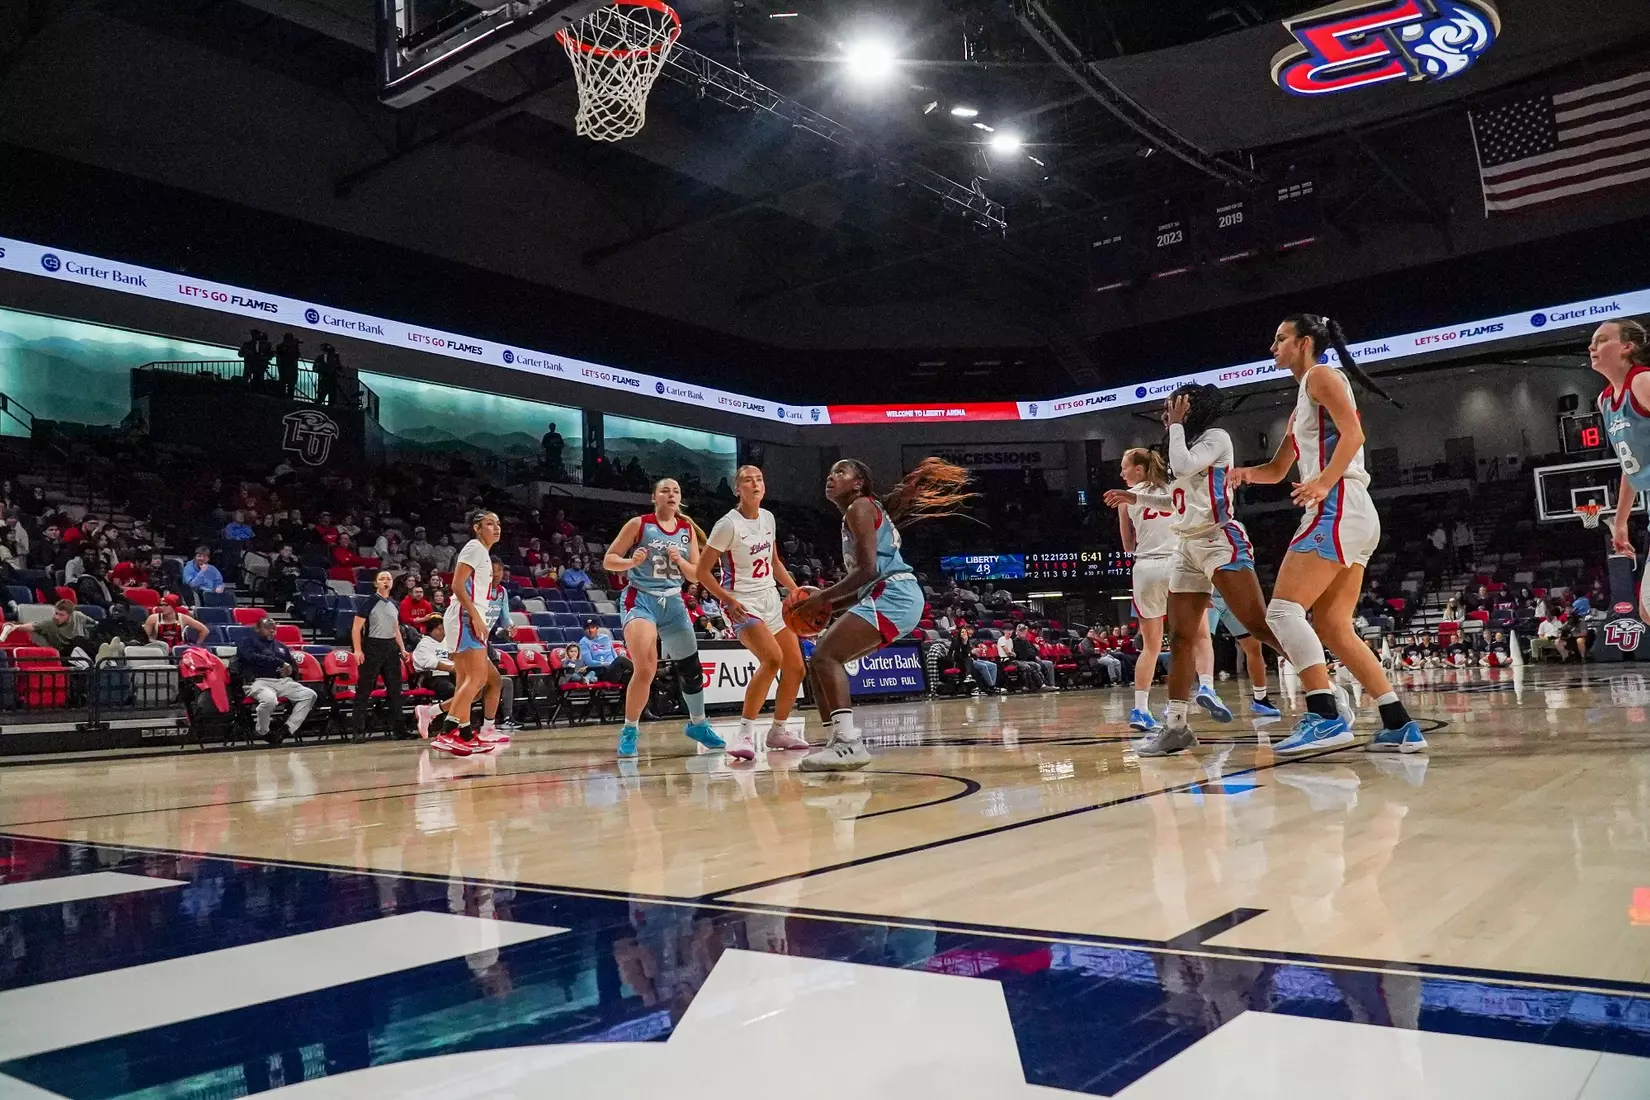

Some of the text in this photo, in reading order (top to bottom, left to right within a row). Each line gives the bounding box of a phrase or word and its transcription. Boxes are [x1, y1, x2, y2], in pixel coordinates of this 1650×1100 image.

[1218, 212, 1243, 228] 2019
[1156, 230, 1183, 247] 2023
[66, 261, 109, 280] Carter
[112, 270, 148, 287] Bank
[179, 284, 278, 313] LET'S GO FLAMES
[1550, 301, 1621, 322] Carter Bank
[323, 314, 356, 330] Carter
[358, 321, 385, 336] Bank
[1415, 323, 1504, 346] LET'S GO FLAMES
[407, 332, 483, 355] LET'S GO FLAMES
[1331, 343, 1390, 361] Cer Bank
[516, 354, 564, 373] Carter Bank
[581, 368, 640, 387] LET'S GO FLAMES
[1218, 370, 1240, 382] LET'S
[1242, 368, 1254, 377] GO
[666, 385, 705, 401] Carter Bank
[1148, 384, 1174, 395] Carter
[717, 396, 765, 413] LET'S GO FLAMES
[1054, 394, 1117, 411] LET'S GO FLAMES
[885, 408, 966, 418] WELCOME TO LIBERTY ARENA
[1582, 427, 1600, 447] 18
[931, 452, 1041, 465] ONCESSIONS
[749, 540, 771, 556] Liberty
[1115, 551, 1121, 559] 3
[965, 555, 1000, 564] LIBERTY
[1032, 553, 1038, 561] 0
[1040, 553, 1050, 561] 12
[1050, 553, 1059, 561] 21
[1059, 553, 1068, 561] 23
[1069, 552, 1078, 560] 31
[1081, 552, 1102, 562] 6:41
[976, 563, 991, 575] 48
[1033, 571, 1039, 579] 2
[1052, 570, 1058, 578] 3
[1062, 570, 1068, 578] 9
[861, 653, 922, 671] Carter Bank
[862, 676, 917, 688] LIFE LIVED FULL
